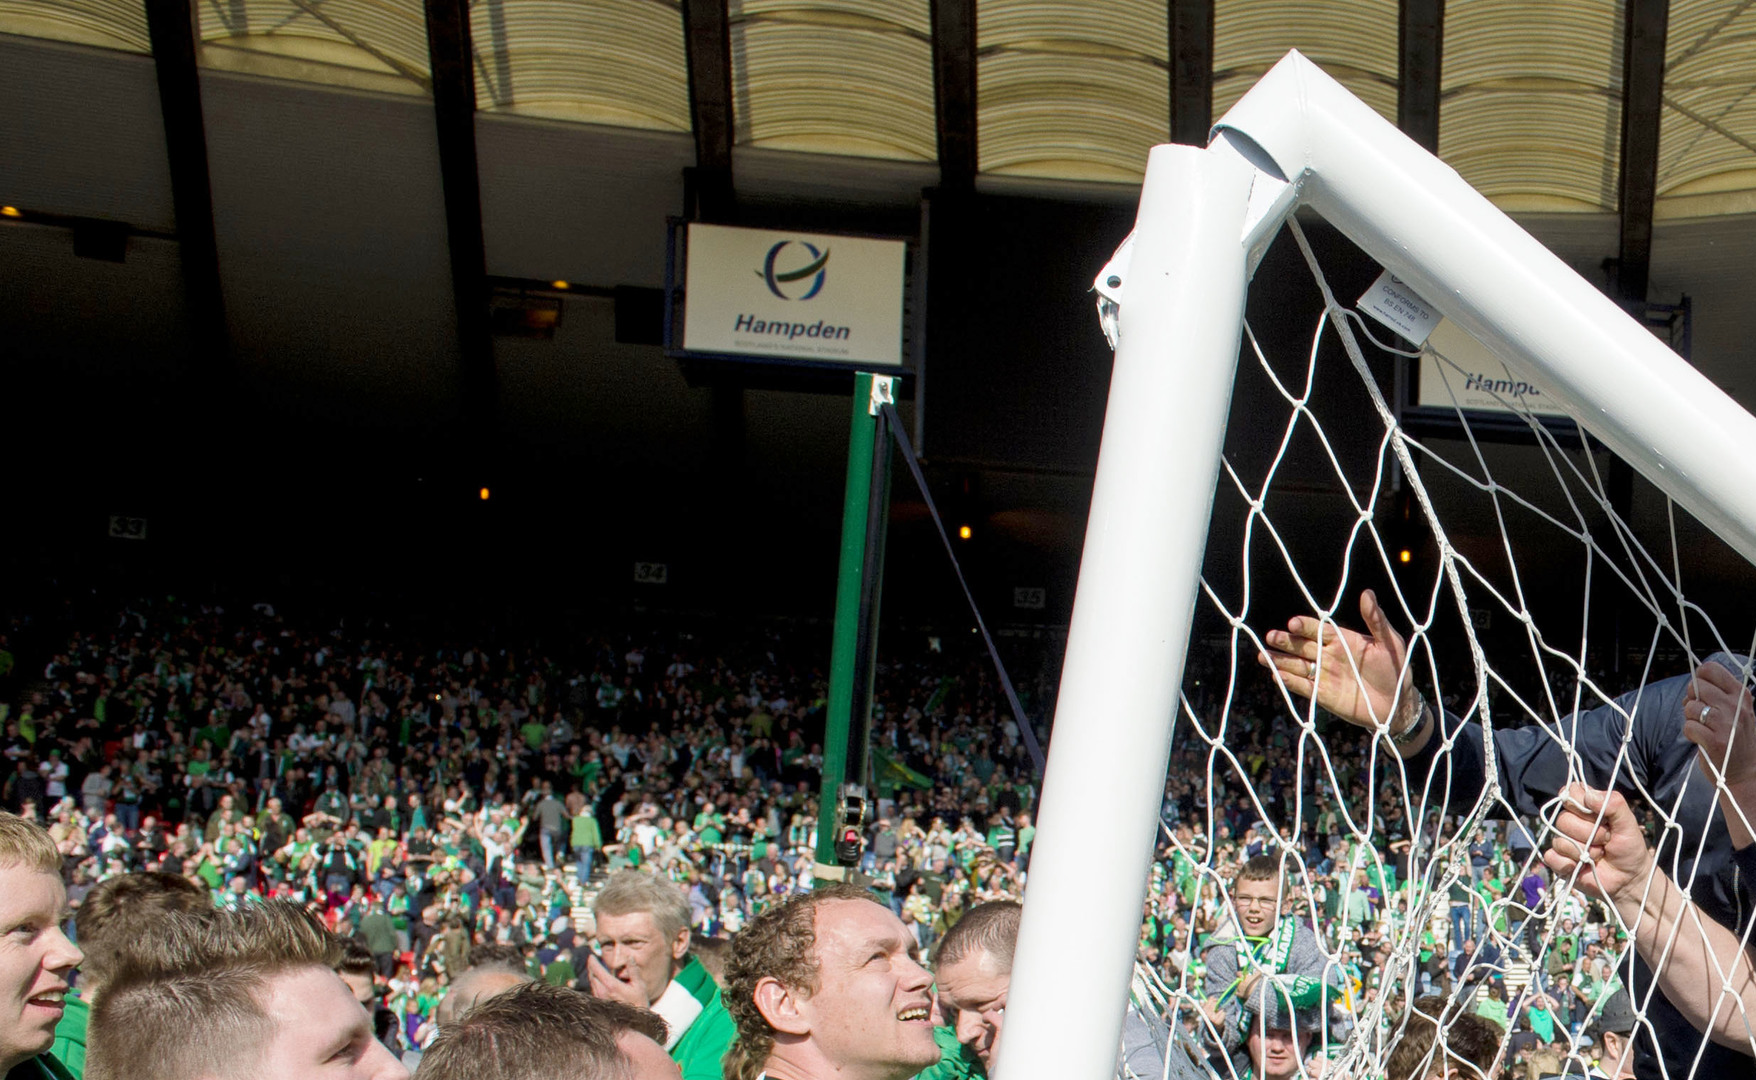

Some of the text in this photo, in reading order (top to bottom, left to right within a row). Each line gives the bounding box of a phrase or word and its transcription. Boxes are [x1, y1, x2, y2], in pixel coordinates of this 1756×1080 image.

[1382, 285, 1429, 320] CONFORMS TO
[1384, 297, 1395, 307] BS
[1394, 304, 1405, 314] EN
[733, 312, 850, 341] Hampden
